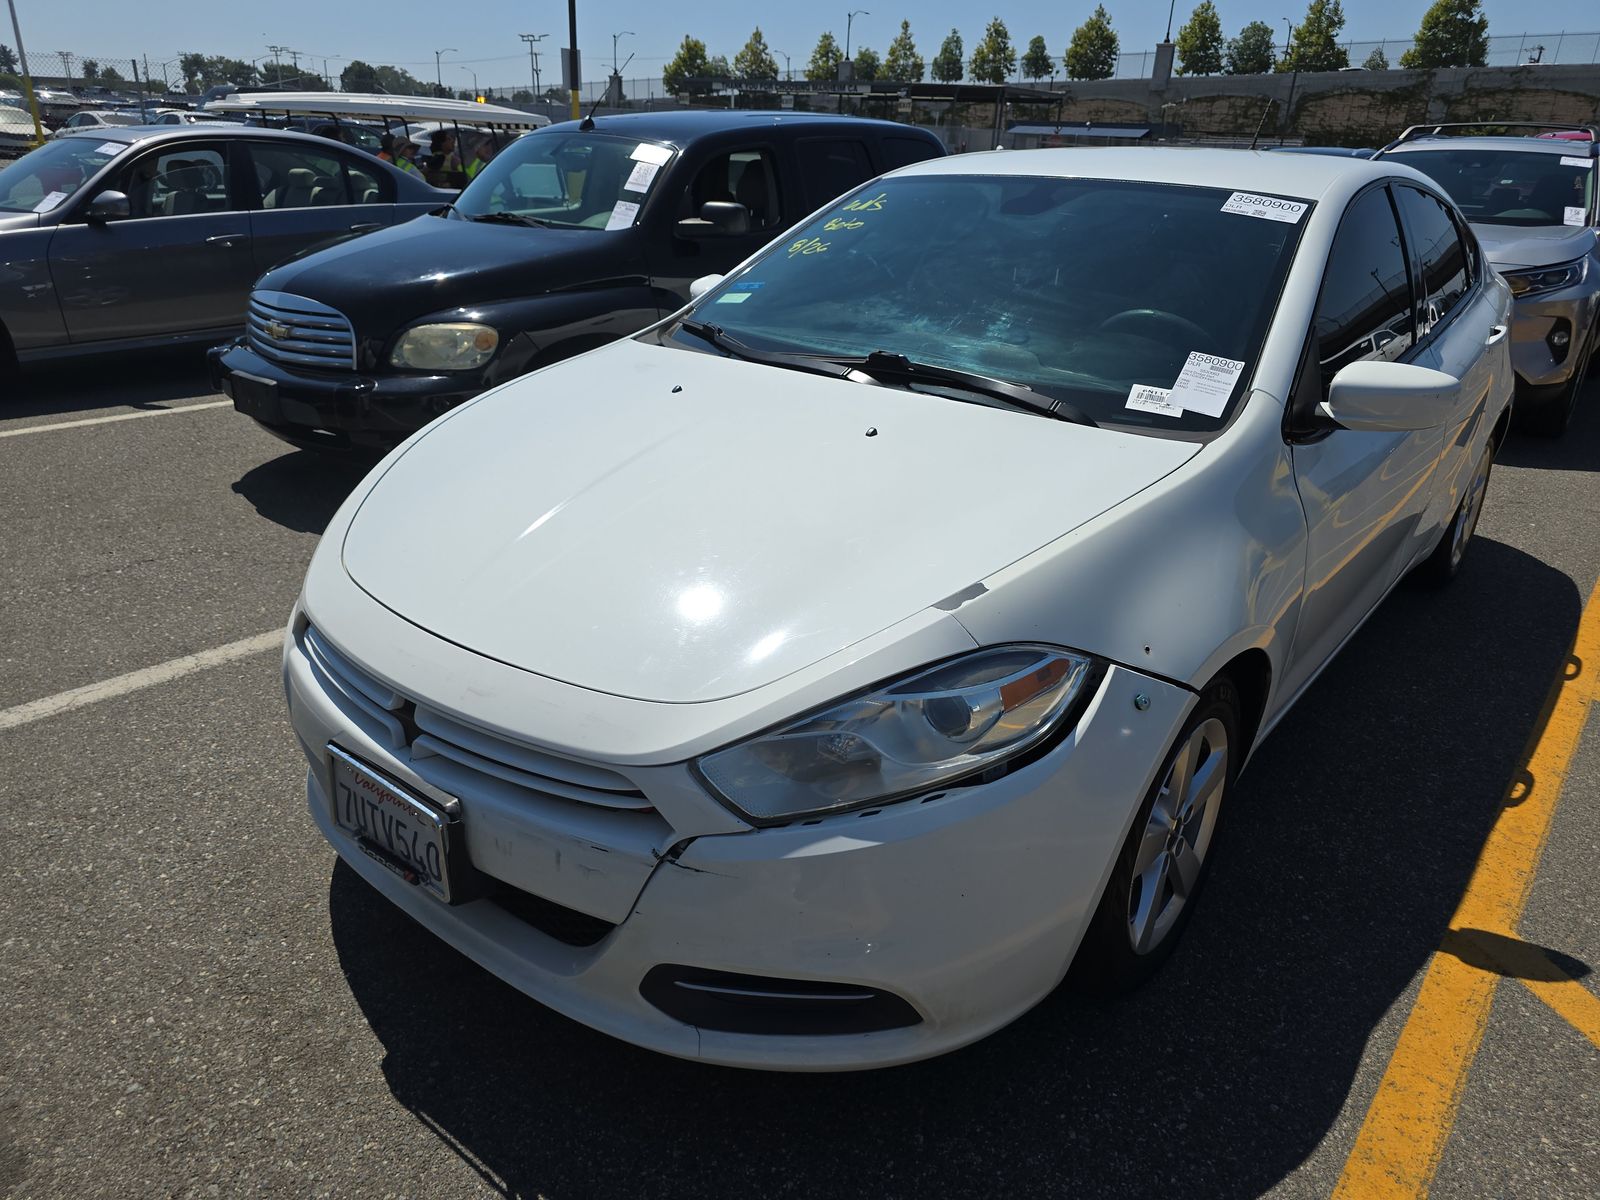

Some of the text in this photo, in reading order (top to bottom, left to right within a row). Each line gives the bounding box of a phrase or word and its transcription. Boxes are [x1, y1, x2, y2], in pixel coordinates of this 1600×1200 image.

[1233, 195, 1301, 212] 3580900
[1188, 353, 1242, 370] 3580900
[339, 782, 443, 882] 7UTV540
